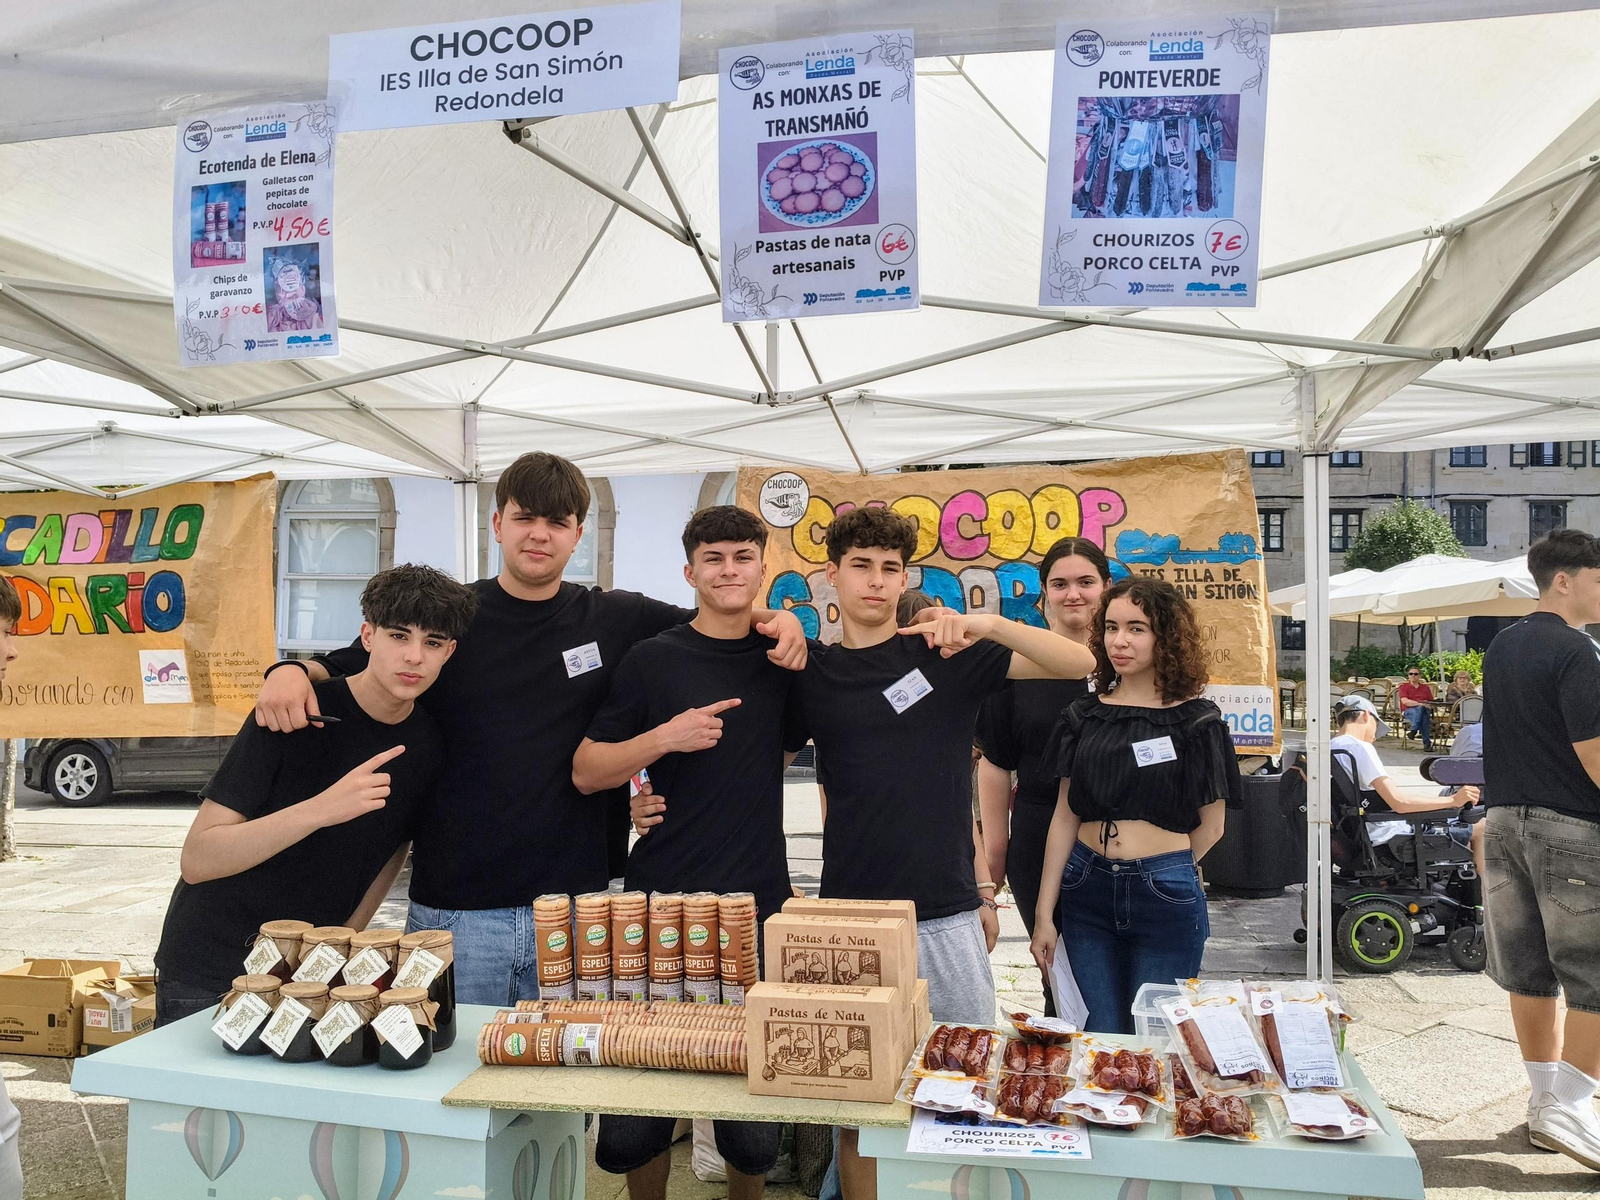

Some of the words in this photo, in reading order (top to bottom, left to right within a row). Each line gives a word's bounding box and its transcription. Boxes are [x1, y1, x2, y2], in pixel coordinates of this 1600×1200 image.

[410, 18, 593, 62] CHOCOOP
[1151, 30, 1203, 38] Asociación
[1072, 34, 1099, 42] CHOCOOP
[1106, 39, 1147, 48] Colaborando
[1149, 38, 1204, 53] Lenda
[806, 48, 854, 57] Asociación
[765, 60, 804, 71] Colaborando
[805, 55, 855, 72] Lenda
[380, 73, 410, 92] IES
[418, 68, 451, 89] Illa
[458, 65, 488, 85] de
[495, 60, 539, 81] San
[547, 50, 623, 76] Simón
[1098, 68, 1221, 89] PONTEVERDE
[435, 85, 564, 113] Redondela
[752, 91, 775, 110] AS
[780, 83, 853, 107] MONXAS
[858, 80, 881, 98] DE
[214, 123, 245, 133] Colaborando
[245, 120, 287, 135] Lenda
[765, 106, 869, 138] TRANSMAÑÓ
[199, 155, 256, 175] Ecotenda
[261, 153, 276, 168] de
[281, 150, 316, 166] Elena
[262, 174, 296, 186] Galletas
[299, 173, 314, 182] con
[266, 187, 297, 200] pepitas
[299, 186, 310, 195] de
[267, 199, 308, 211] chocolate
[253, 220, 274, 230] P.V.P
[755, 237, 807, 254] Pastas
[810, 234, 830, 249] de
[834, 233, 871, 247] nata
[881, 230, 909, 255] 6€
[1092, 233, 1195, 247] CHOURIZOS
[1210, 232, 1242, 253] 7€
[772, 257, 856, 275] artesanais
[1083, 256, 1143, 270] PORCO
[1148, 256, 1202, 270] CELTA
[879, 269, 905, 282] PVP
[1211, 265, 1240, 277] PVP
[213, 275, 236, 285] Chips
[238, 273, 248, 282] de
[210, 287, 253, 300] garavanzo
[199, 309, 219, 319] P.V.P
[767, 478, 803, 489] CHOCOOP
[1173, 567, 1213, 583] ILLA
[1223, 567, 1242, 582] DE
[1205, 580, 1260, 600] SIMÓN
[103, 685, 134, 706] con
[786, 933, 822, 944] Pastas
[828, 933, 842, 944] de
[847, 935, 876, 947] Nata
[686, 958, 715, 968] ESPELTA
[769, 1007, 808, 1019] Pastas
[815, 1008, 828, 1020] de
[835, 1010, 865, 1021] Nata
[540, 1027, 552, 1062] ESPELTA
[952, 1129, 1036, 1139] CHOURIZOS
[944, 1137, 994, 1146] PORCO
[999, 1138, 1043, 1147] CELTA
